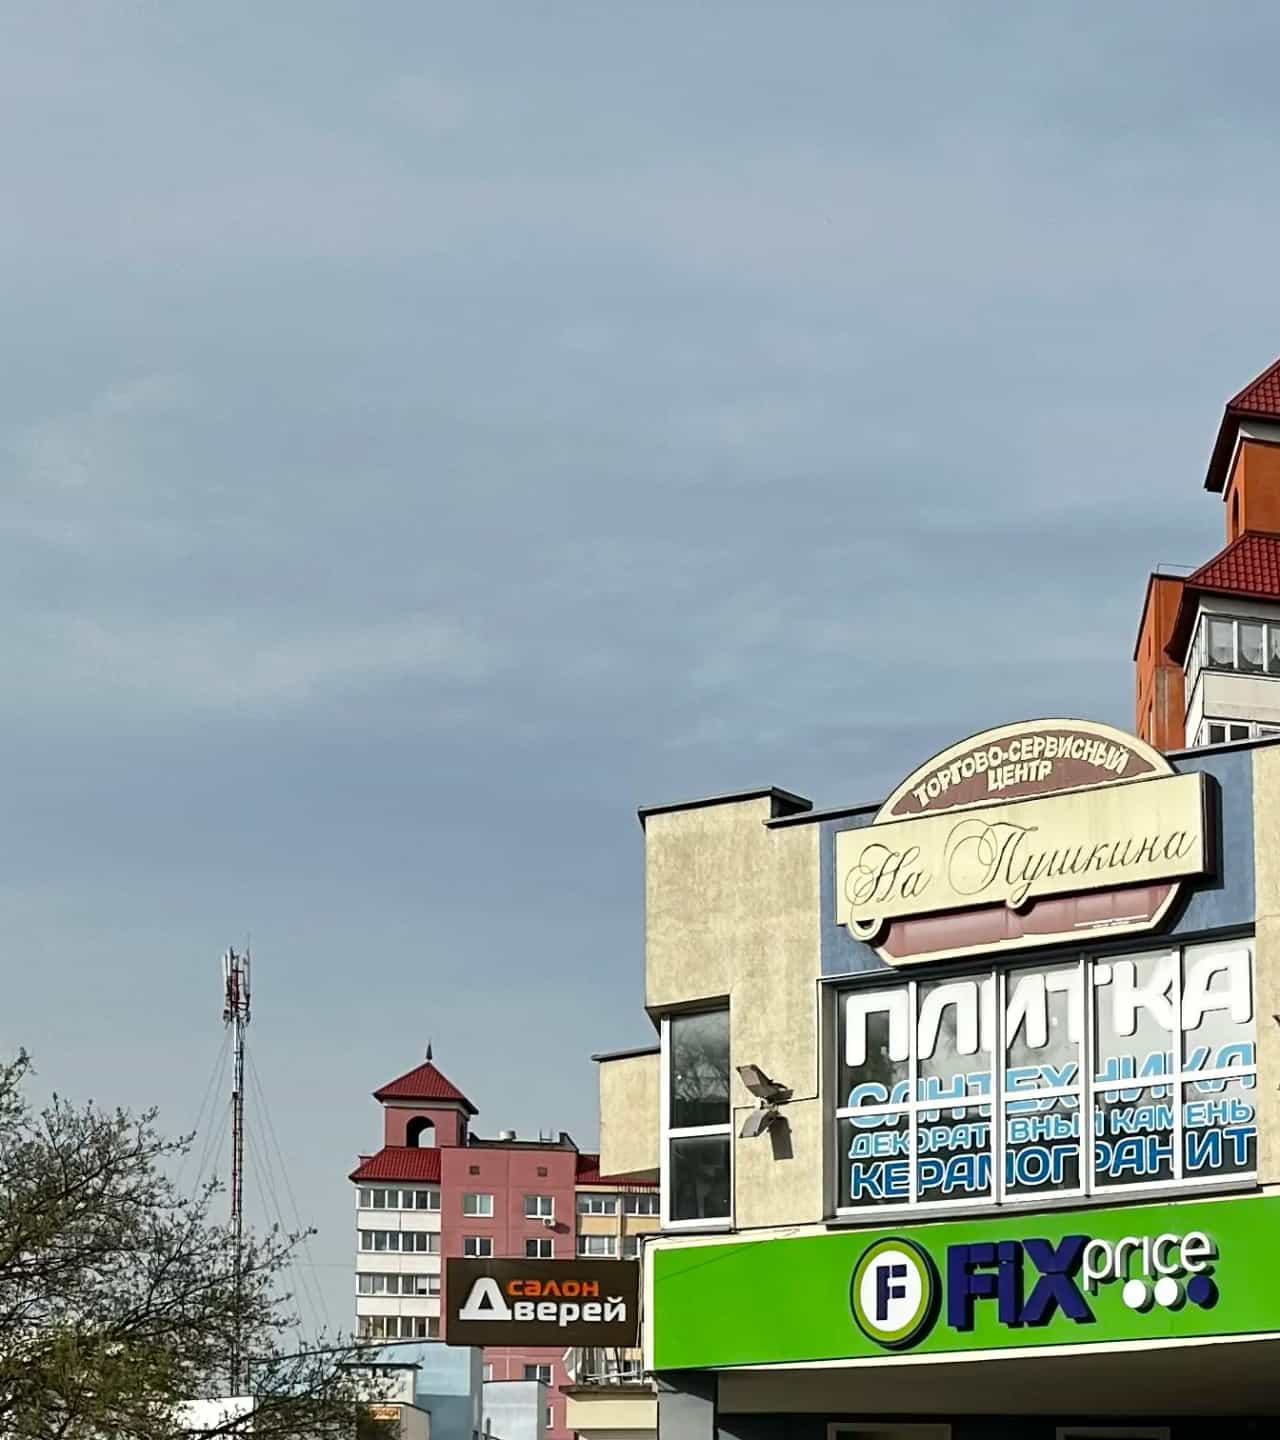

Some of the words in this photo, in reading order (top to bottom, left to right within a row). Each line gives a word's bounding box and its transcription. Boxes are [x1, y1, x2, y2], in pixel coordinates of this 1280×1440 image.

[912, 735, 1130, 808] ТОРГОВО-СЕРВИСНЫЙ
[987, 759, 1053, 792] ЦЕНТР
[845, 843, 931, 926] На
[945, 819, 1198, 907] Пушкина
[845, 947, 1254, 1066] ПЛИТКА
[848, 1041, 1256, 1128] САНТЕХНИКА
[848, 1105, 1104, 1159] ДЕКОРАТВНЫ
[1110, 1098, 1254, 1135] КАМЕНЬ
[851, 1126, 1257, 1200] КЕРАМОГРАНИТ
[459, 1276, 627, 1327] Дверей
[505, 1279, 600, 1297] салон
[875, 1263, 908, 1321] F
[947, 1235, 1095, 1331] FIX
[1082, 1231, 1212, 1292] price
